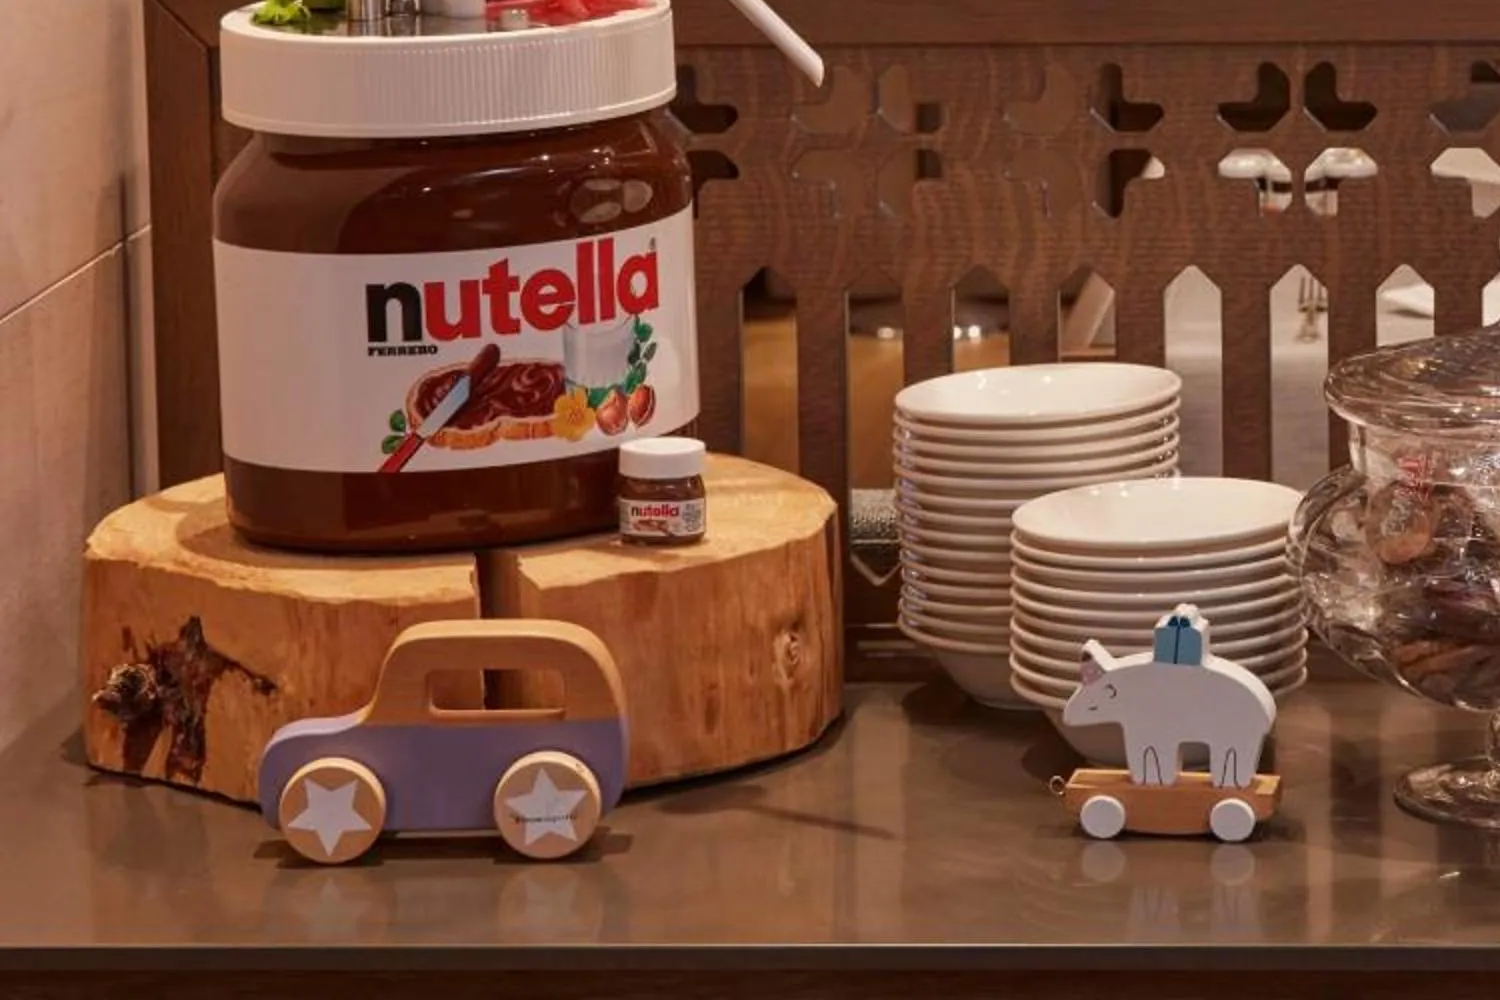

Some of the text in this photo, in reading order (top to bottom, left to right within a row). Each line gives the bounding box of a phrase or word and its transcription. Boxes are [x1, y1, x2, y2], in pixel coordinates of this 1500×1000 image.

[365, 237, 659, 342] nutella
[367, 343, 438, 357] FERRERO
[631, 503, 679, 517] nutella
